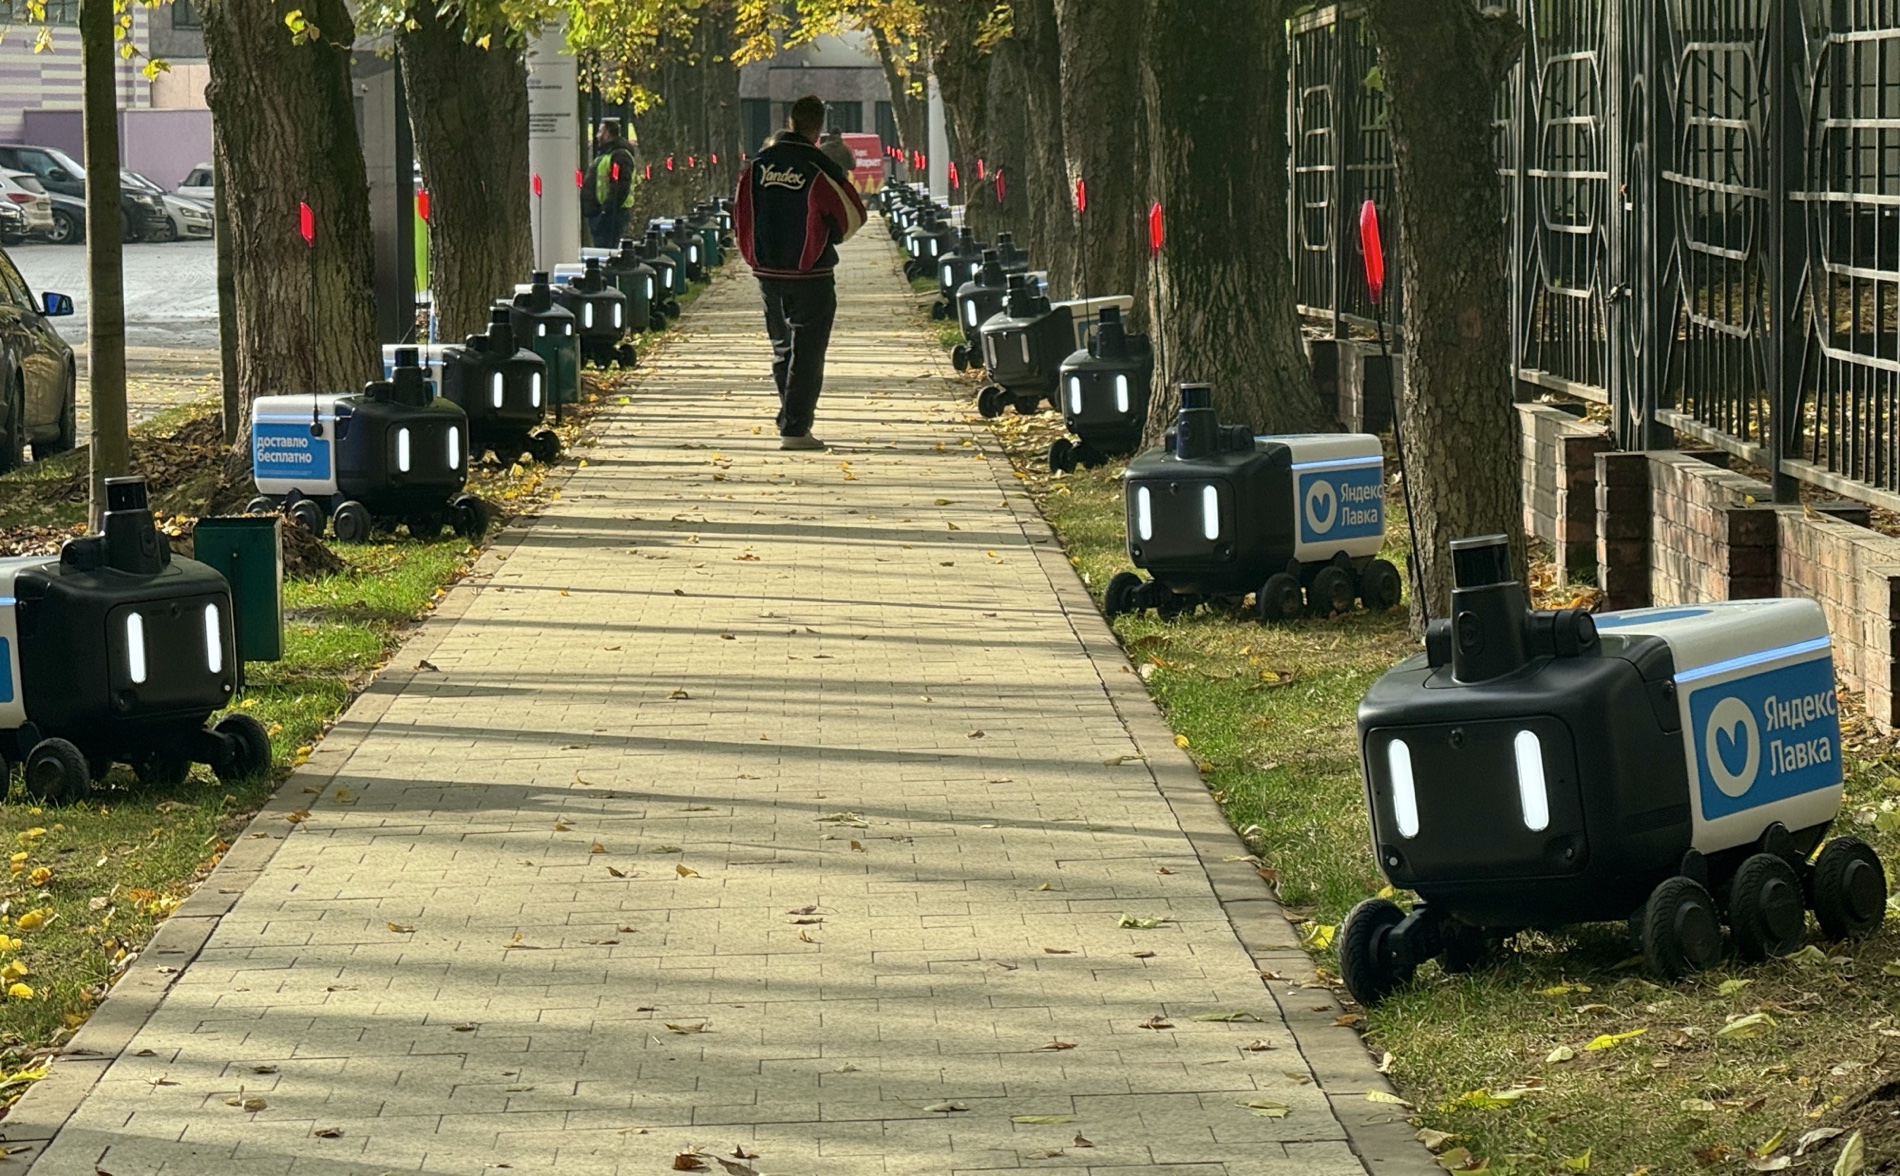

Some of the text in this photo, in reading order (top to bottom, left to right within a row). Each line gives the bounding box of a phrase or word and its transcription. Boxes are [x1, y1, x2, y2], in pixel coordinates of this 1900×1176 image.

[760, 164, 806, 190] Yandex
[257, 437, 308, 448] доставлю
[257, 449, 312, 463] бесплатно
[1341, 483, 1384, 503] Яндекс
[1341, 507, 1378, 526] Лавка
[1764, 690, 1836, 732] Яндекс
[1770, 736, 1832, 777] Лавка
